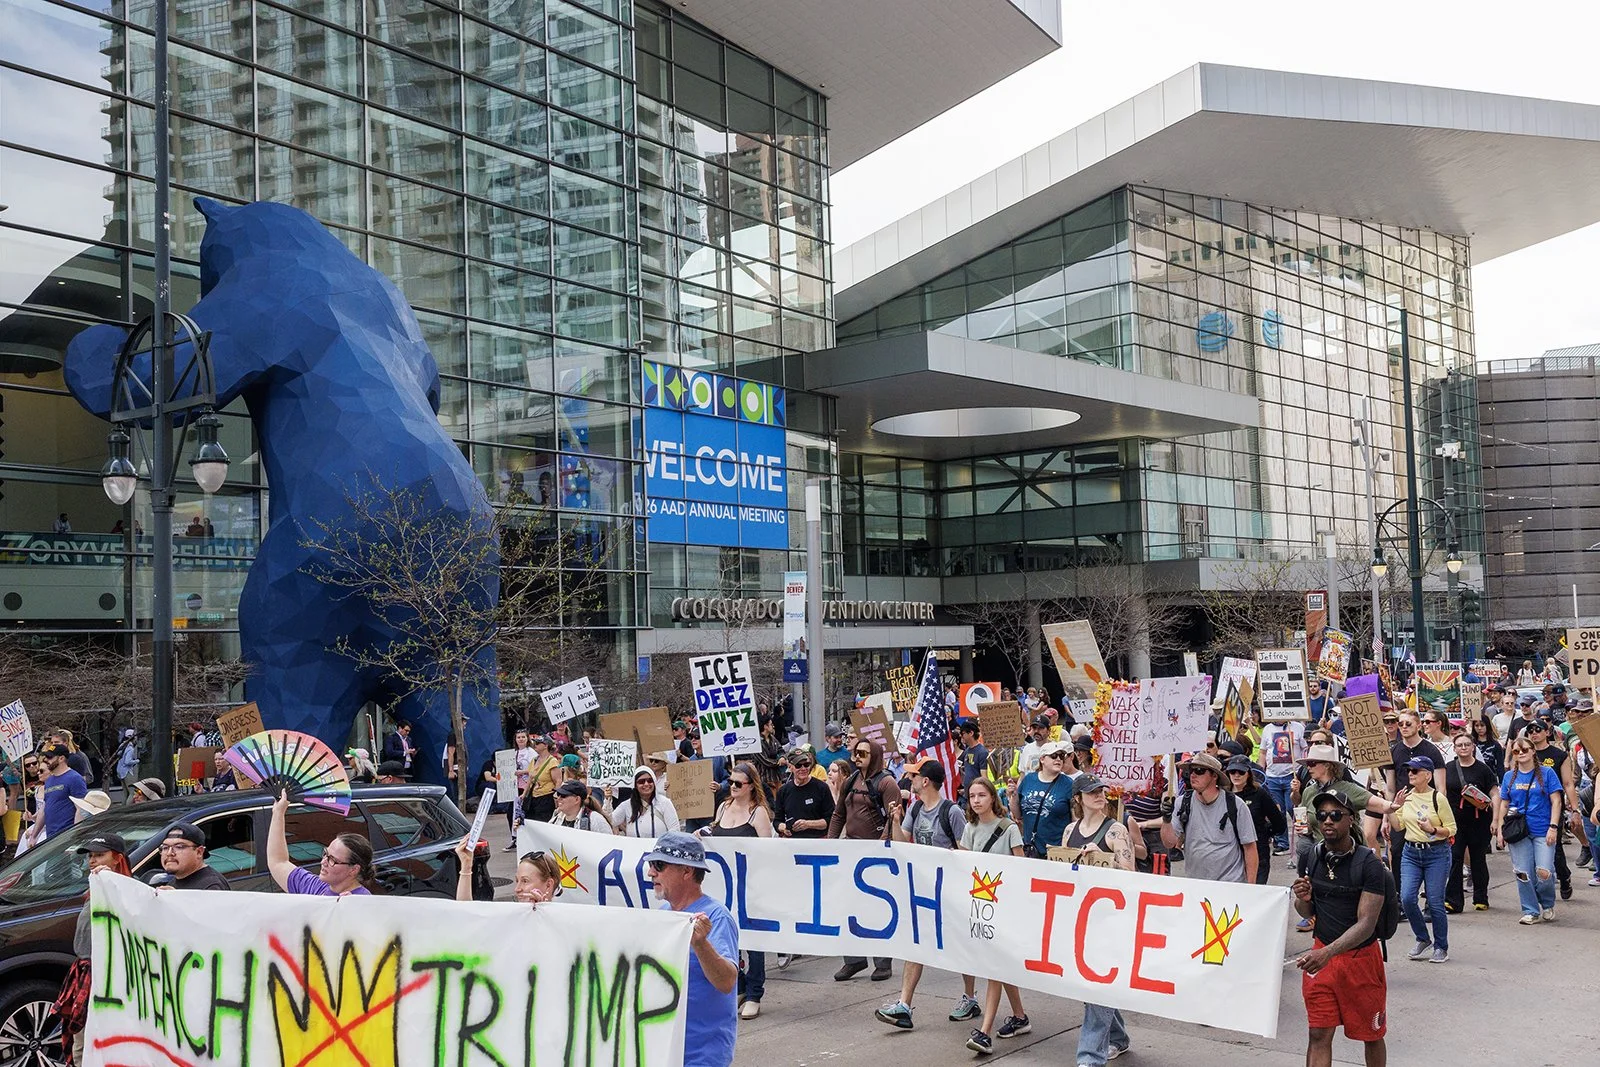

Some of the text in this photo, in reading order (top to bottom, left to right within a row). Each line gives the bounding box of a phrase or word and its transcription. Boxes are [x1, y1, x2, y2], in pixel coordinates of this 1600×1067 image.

[634, 437, 783, 492] WELCOME
[661, 499, 685, 517] AAD
[689, 503, 736, 521] ANNUAL
[739, 507, 784, 524] MEETING
[1, 535, 124, 563] ZORYVE
[675, 599, 934, 620] COLORADO VENTION CENTER
[1574, 640, 1600, 651] SIG
[1258, 652, 1288, 661] Jeffrey
[694, 654, 746, 688] ICE
[886, 665, 915, 680] LEFT OR
[1275, 673, 1285, 682] by
[891, 675, 916, 690] RIGHT
[1284, 683, 1300, 691] that
[544, 682, 586, 702] TRUMP IS
[695, 684, 751, 711] DEEZ
[1262, 692, 1284, 701] Donald
[552, 691, 594, 711] NOT ABOVE
[896, 698, 917, 711] WRON
[1109, 696, 1140, 711] WAK
[1344, 700, 1370, 717] NOT
[0, 700, 24, 723] KINGS
[555, 712, 567, 720] THE
[1109, 713, 1130, 726] UP
[1267, 708, 1272, 718] 3
[1, 717, 24, 738] SINCE
[220, 711, 257, 735] ONGRESS
[699, 707, 756, 735] NUTZ
[1347, 713, 1379, 730] PAID
[230, 731, 242, 743] GET
[1102, 729, 1138, 744] SMEL
[1367, 727, 1384, 735] HERE
[1357, 741, 1373, 749] CAME
[1374, 739, 1385, 747] FOR
[604, 754, 633, 767] HOLD MY
[1094, 764, 1154, 780] FASCISM
[971, 899, 994, 921] NO
[969, 918, 995, 940] KINGS
[1025, 877, 1185, 994] ICE
[92, 911, 681, 1067] IMPEACH TRUMP
